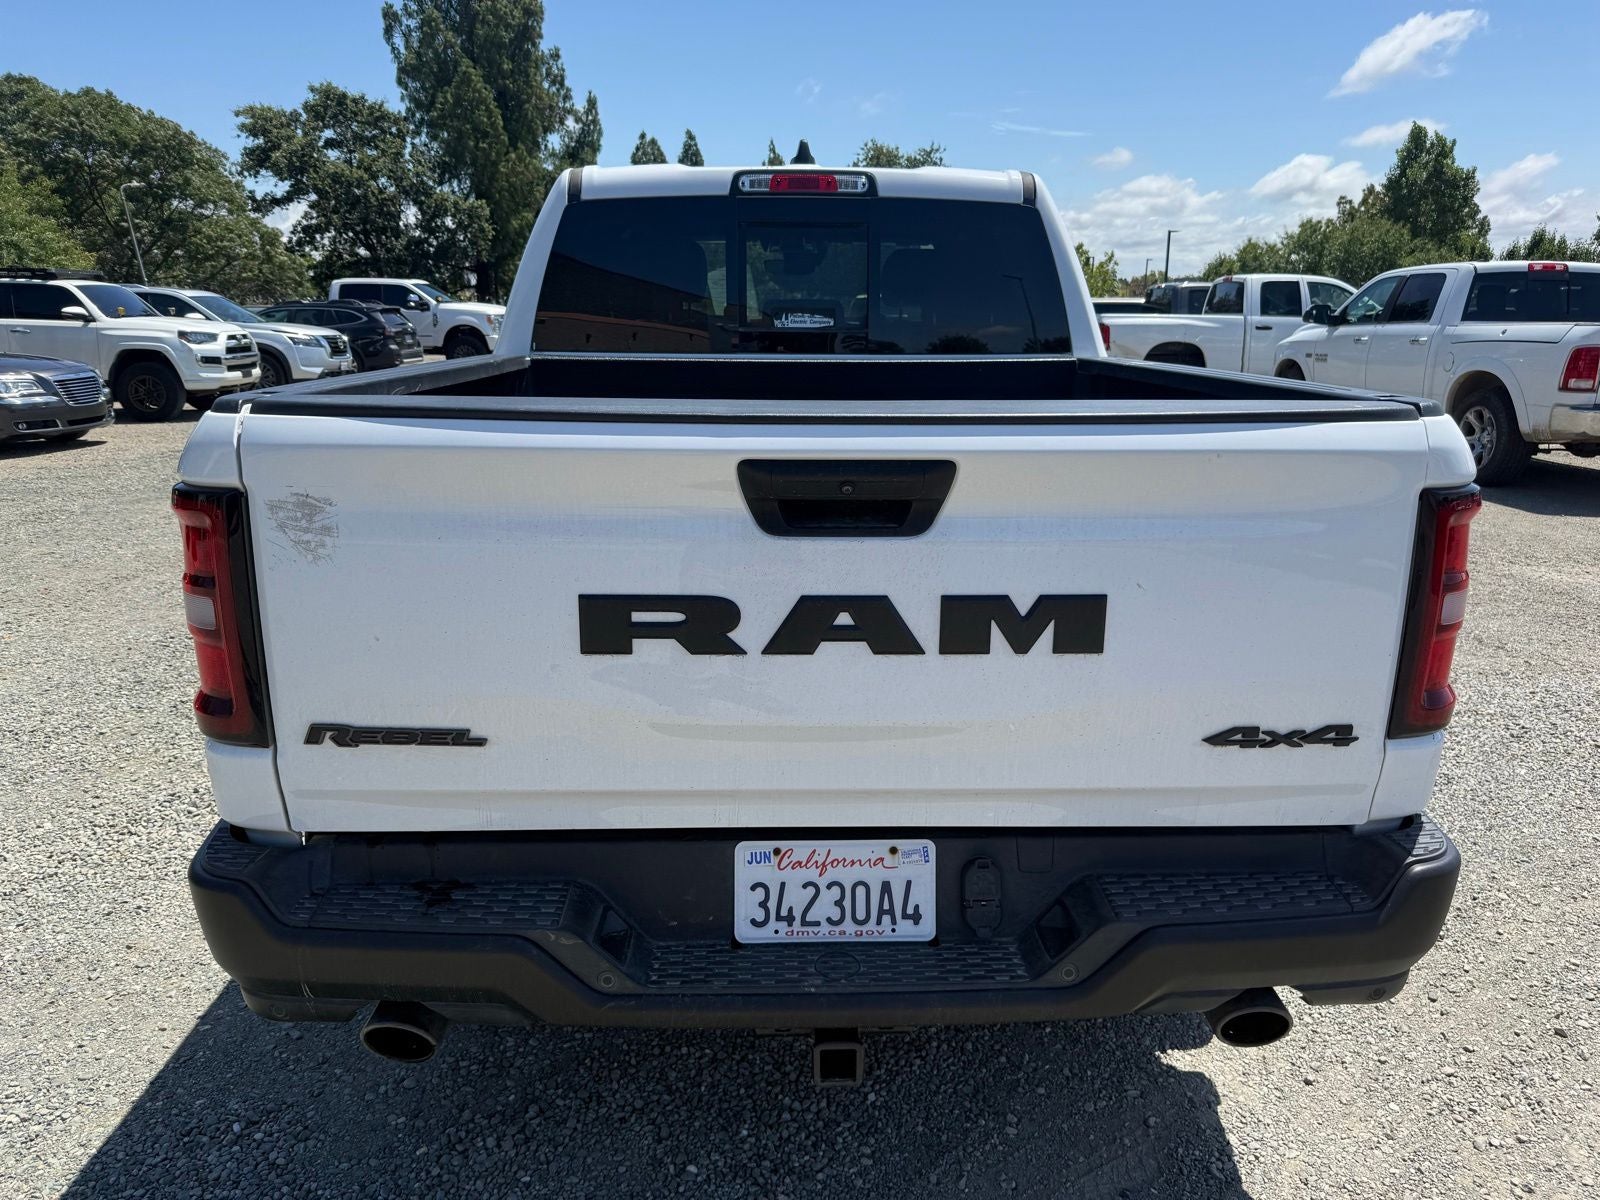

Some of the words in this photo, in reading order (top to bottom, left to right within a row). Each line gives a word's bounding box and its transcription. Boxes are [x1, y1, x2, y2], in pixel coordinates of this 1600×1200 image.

[578, 594, 1108, 654] RAM
[304, 723, 488, 748] REBEL
[1202, 724, 1360, 748] 4x4
[747, 850, 772, 865] JUN
[777, 849, 898, 877] California
[750, 880, 922, 928] 34230A4
[785, 929, 886, 937] dmv.ca.gov
